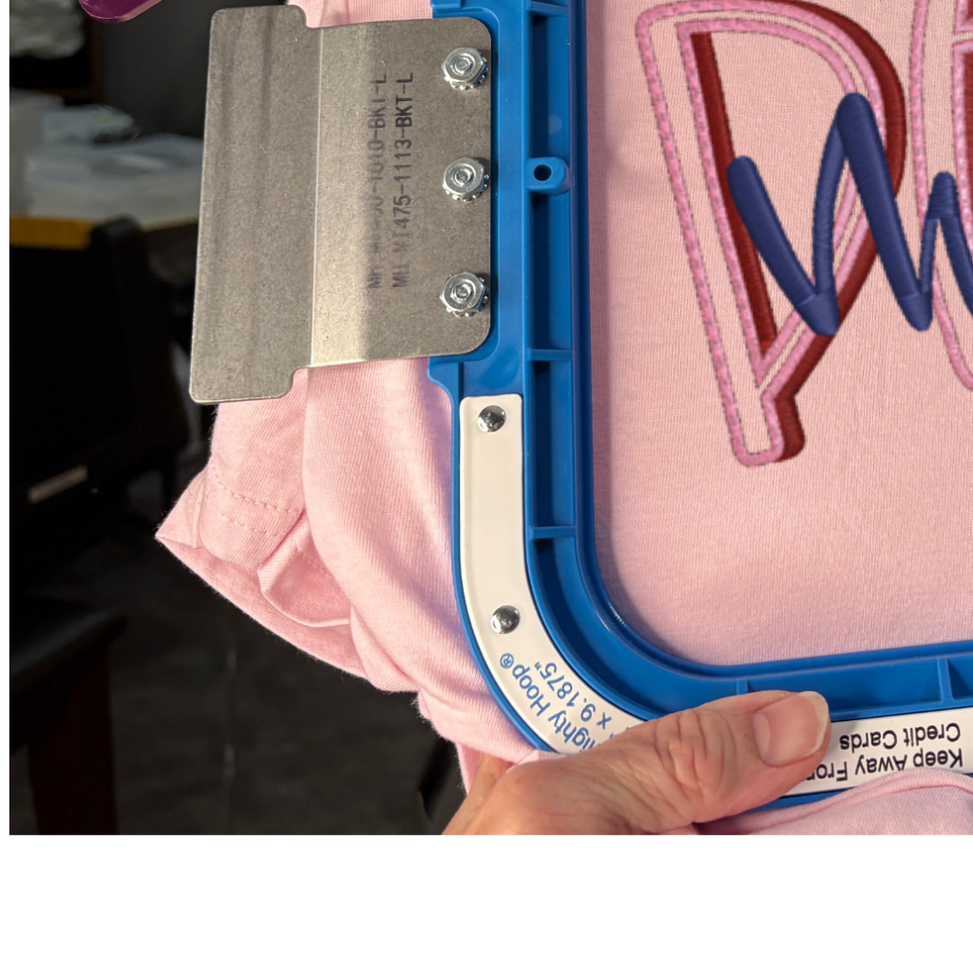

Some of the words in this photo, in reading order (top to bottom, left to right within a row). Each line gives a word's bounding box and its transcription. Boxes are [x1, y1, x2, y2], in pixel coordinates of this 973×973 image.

[393, 72, 414, 288] MHMT475-1113-BKT-L
[548, 710, 595, 751] ighty
[596, 712, 612, 730] x
[839, 729, 897, 754] Cards
[903, 722, 961, 747] Credit
[855, 754, 907, 776] Away
[913, 748, 963, 768] Keep
